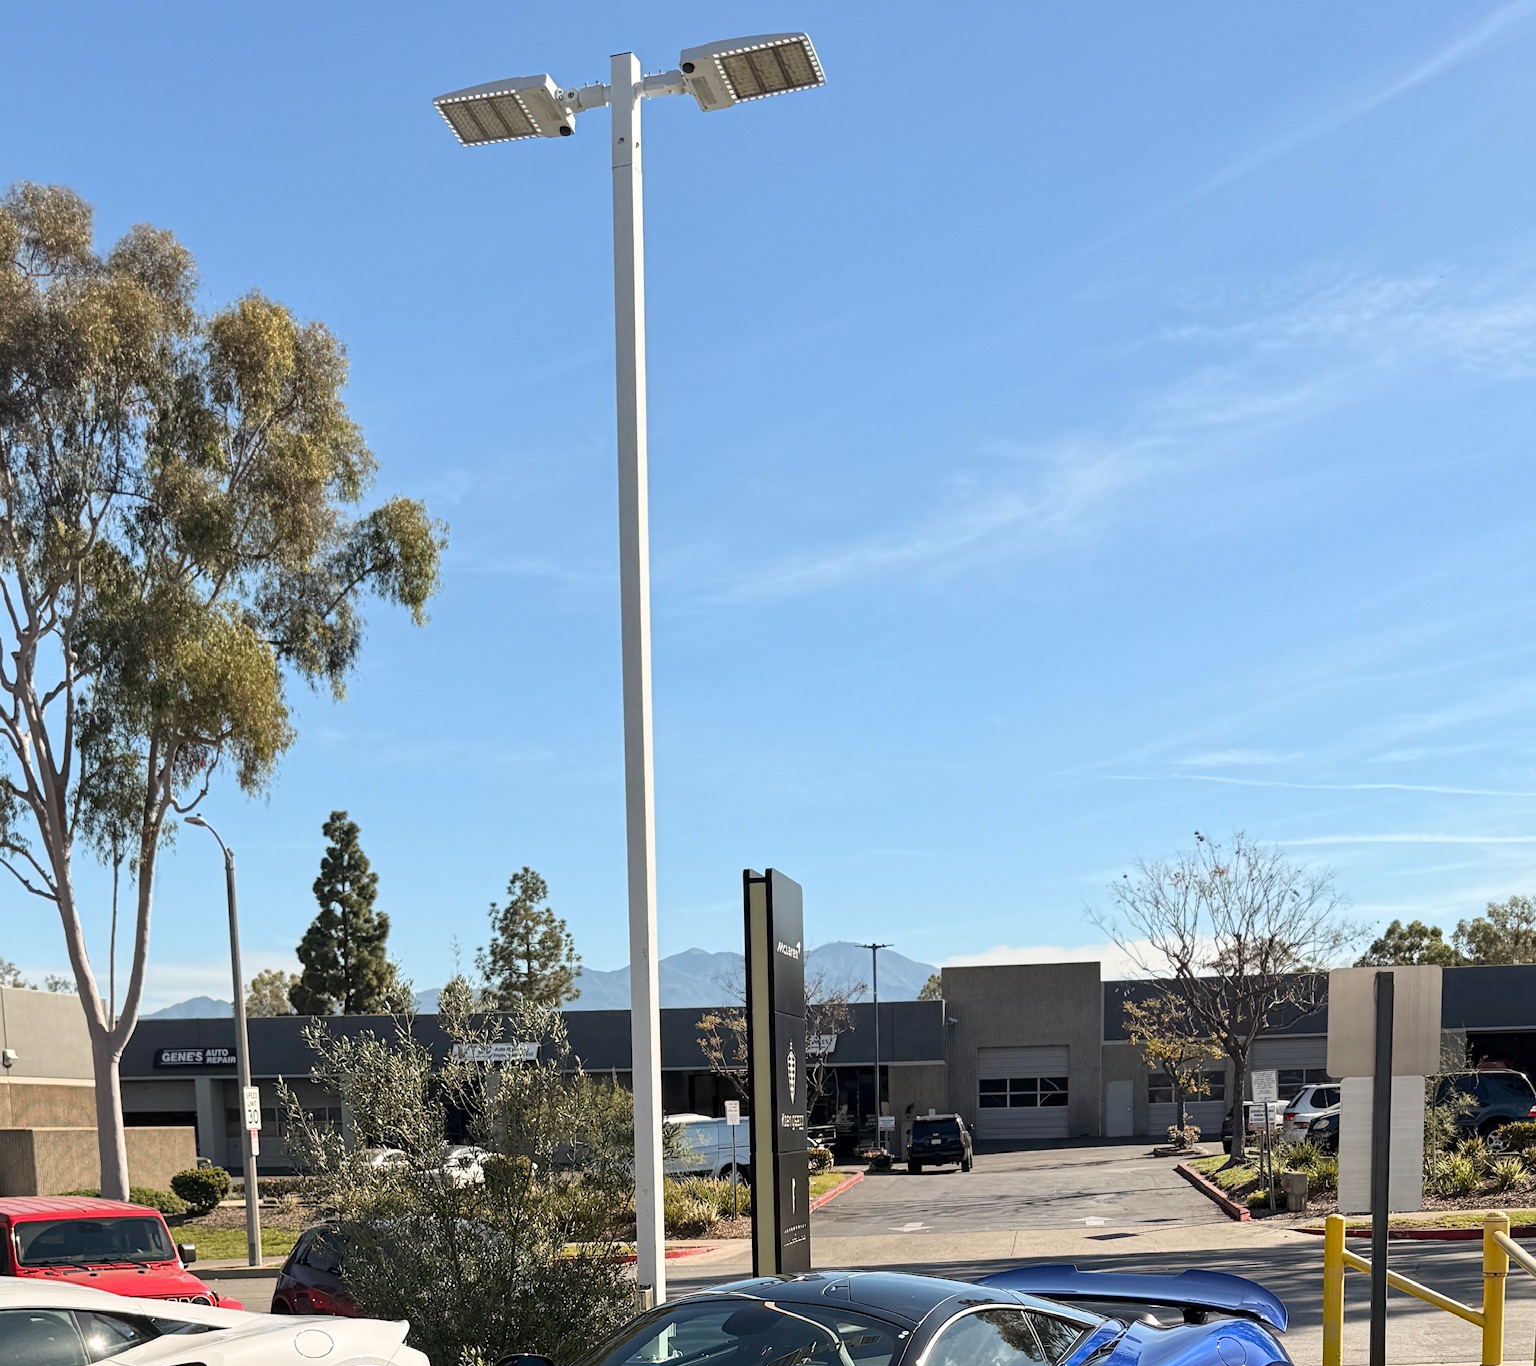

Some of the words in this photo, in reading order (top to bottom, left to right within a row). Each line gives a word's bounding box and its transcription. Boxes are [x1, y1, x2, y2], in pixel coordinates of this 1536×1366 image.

[161, 1052, 203, 1062] GENE'S
[206, 1049, 229, 1057] AUTO
[248, 1109, 259, 1124] 30
